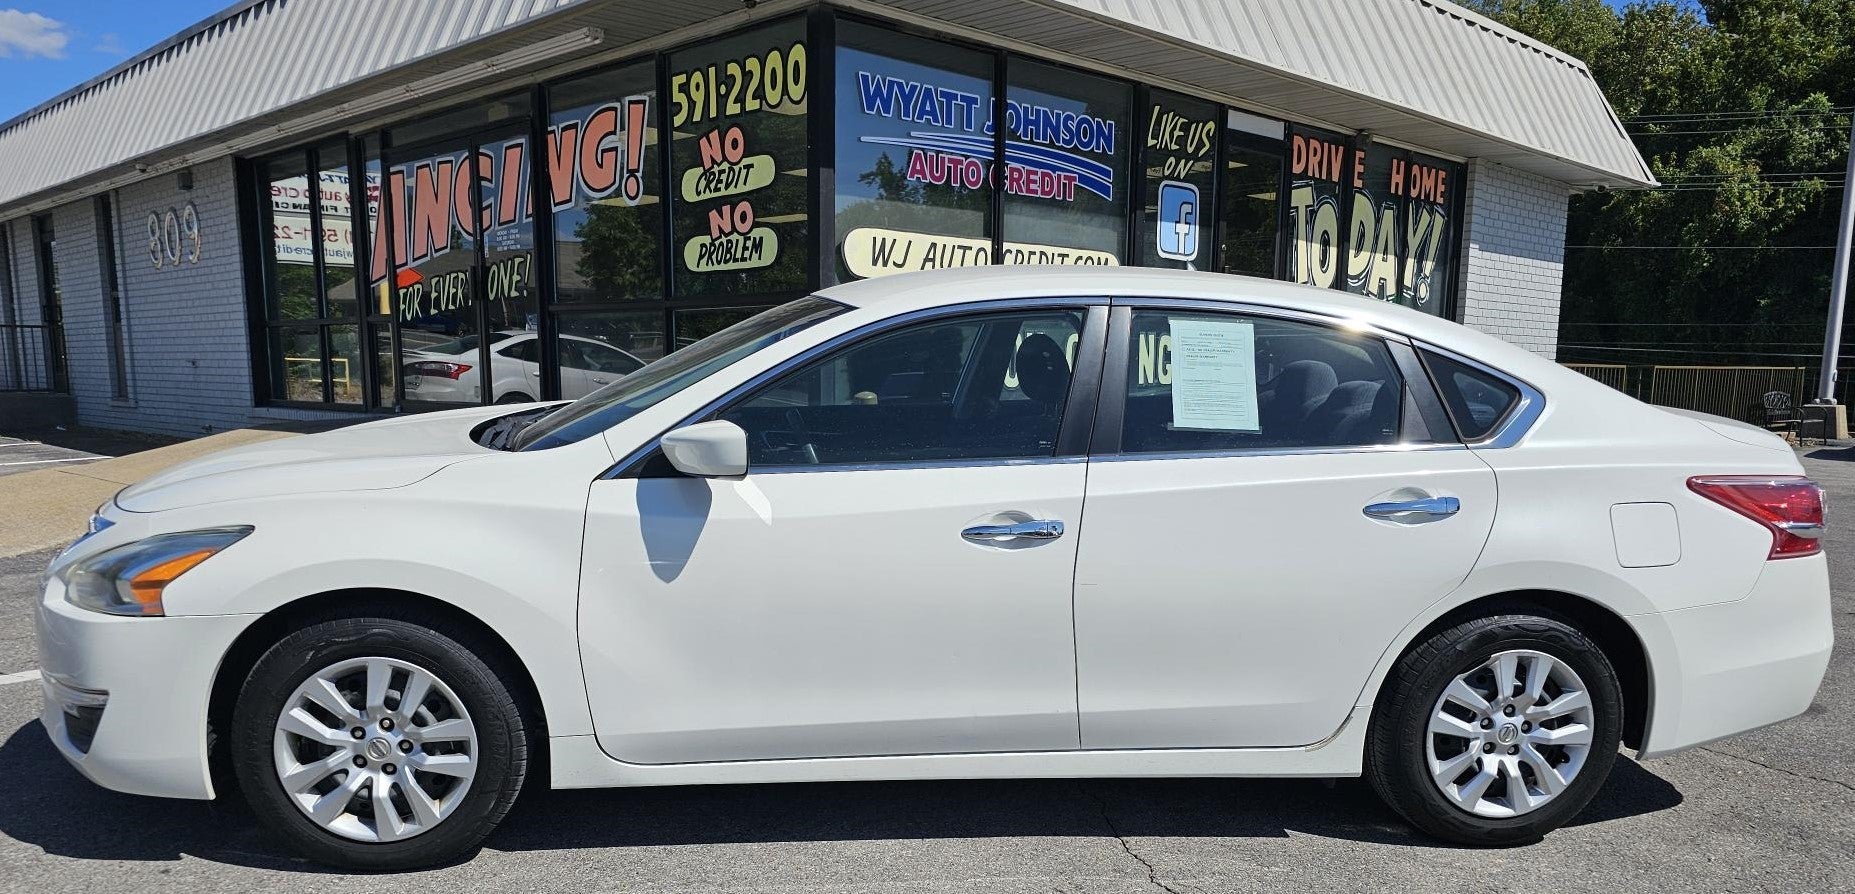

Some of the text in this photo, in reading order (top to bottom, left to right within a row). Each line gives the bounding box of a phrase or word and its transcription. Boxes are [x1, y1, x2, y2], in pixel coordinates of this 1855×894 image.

[858, 71, 1114, 154] WYATT JOHNSON
[1147, 105, 1216, 157] LIKE US
[699, 126, 745, 171] NO
[1164, 156, 1194, 180] ON
[1292, 133, 1446, 204] DRIVE HOME
[695, 163, 755, 197] CREDIT
[907, 150, 1079, 201] AUTO CREDIT
[147, 201, 201, 270] 809
[708, 200, 754, 240] NO
[697, 236, 764, 268] PROBLEM
[871, 236, 912, 268] WJ
[1290, 181, 1448, 305] TODAY!
[398, 284, 423, 322] FOR
